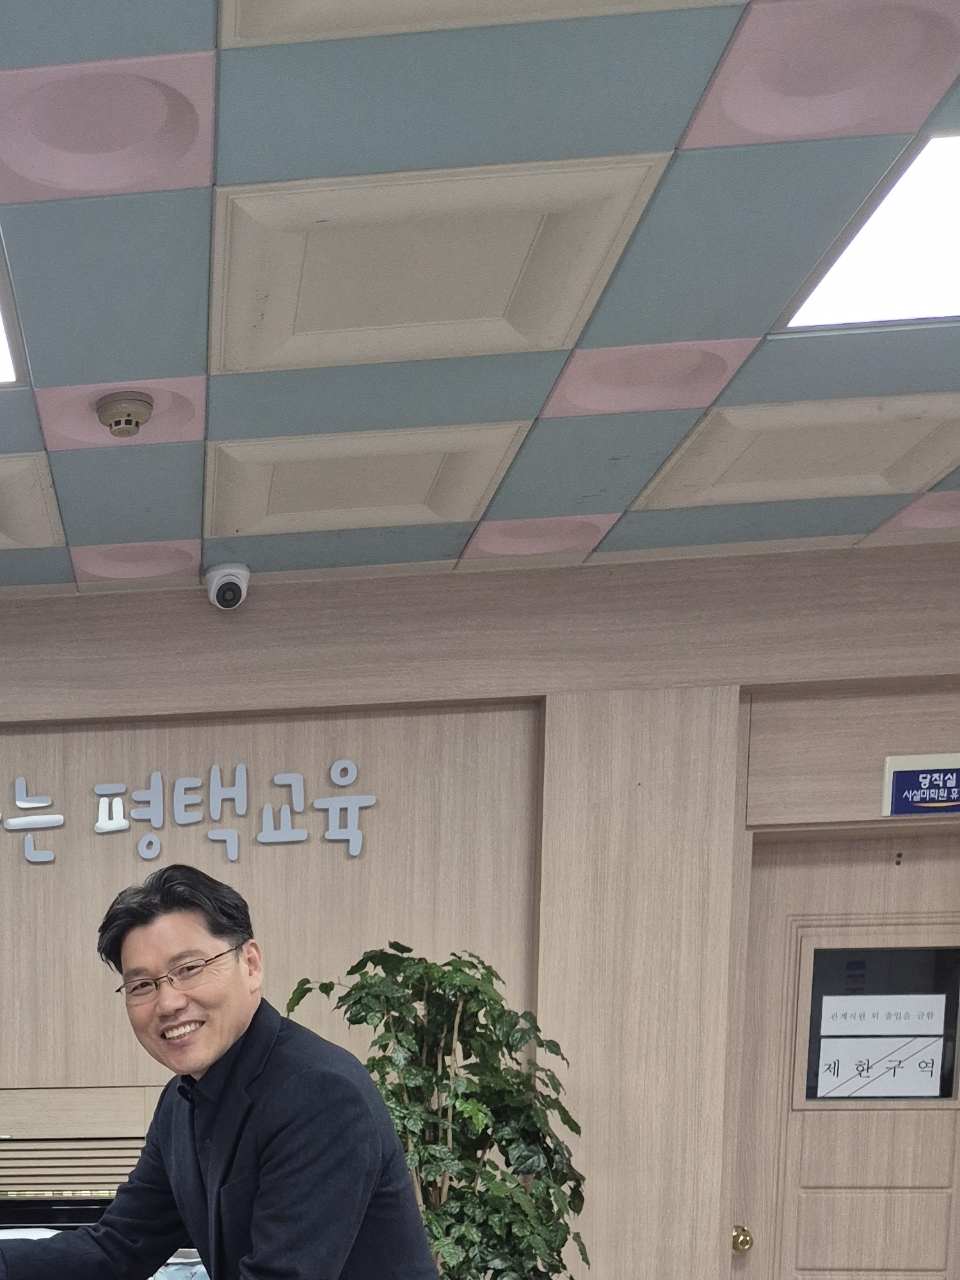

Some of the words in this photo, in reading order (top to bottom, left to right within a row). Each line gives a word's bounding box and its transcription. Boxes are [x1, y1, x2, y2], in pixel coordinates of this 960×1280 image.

[918, 772, 957, 789] 당직실
[93, 759, 377, 861] 평택교육
[822, 1058, 935, 1079] 제한구역
